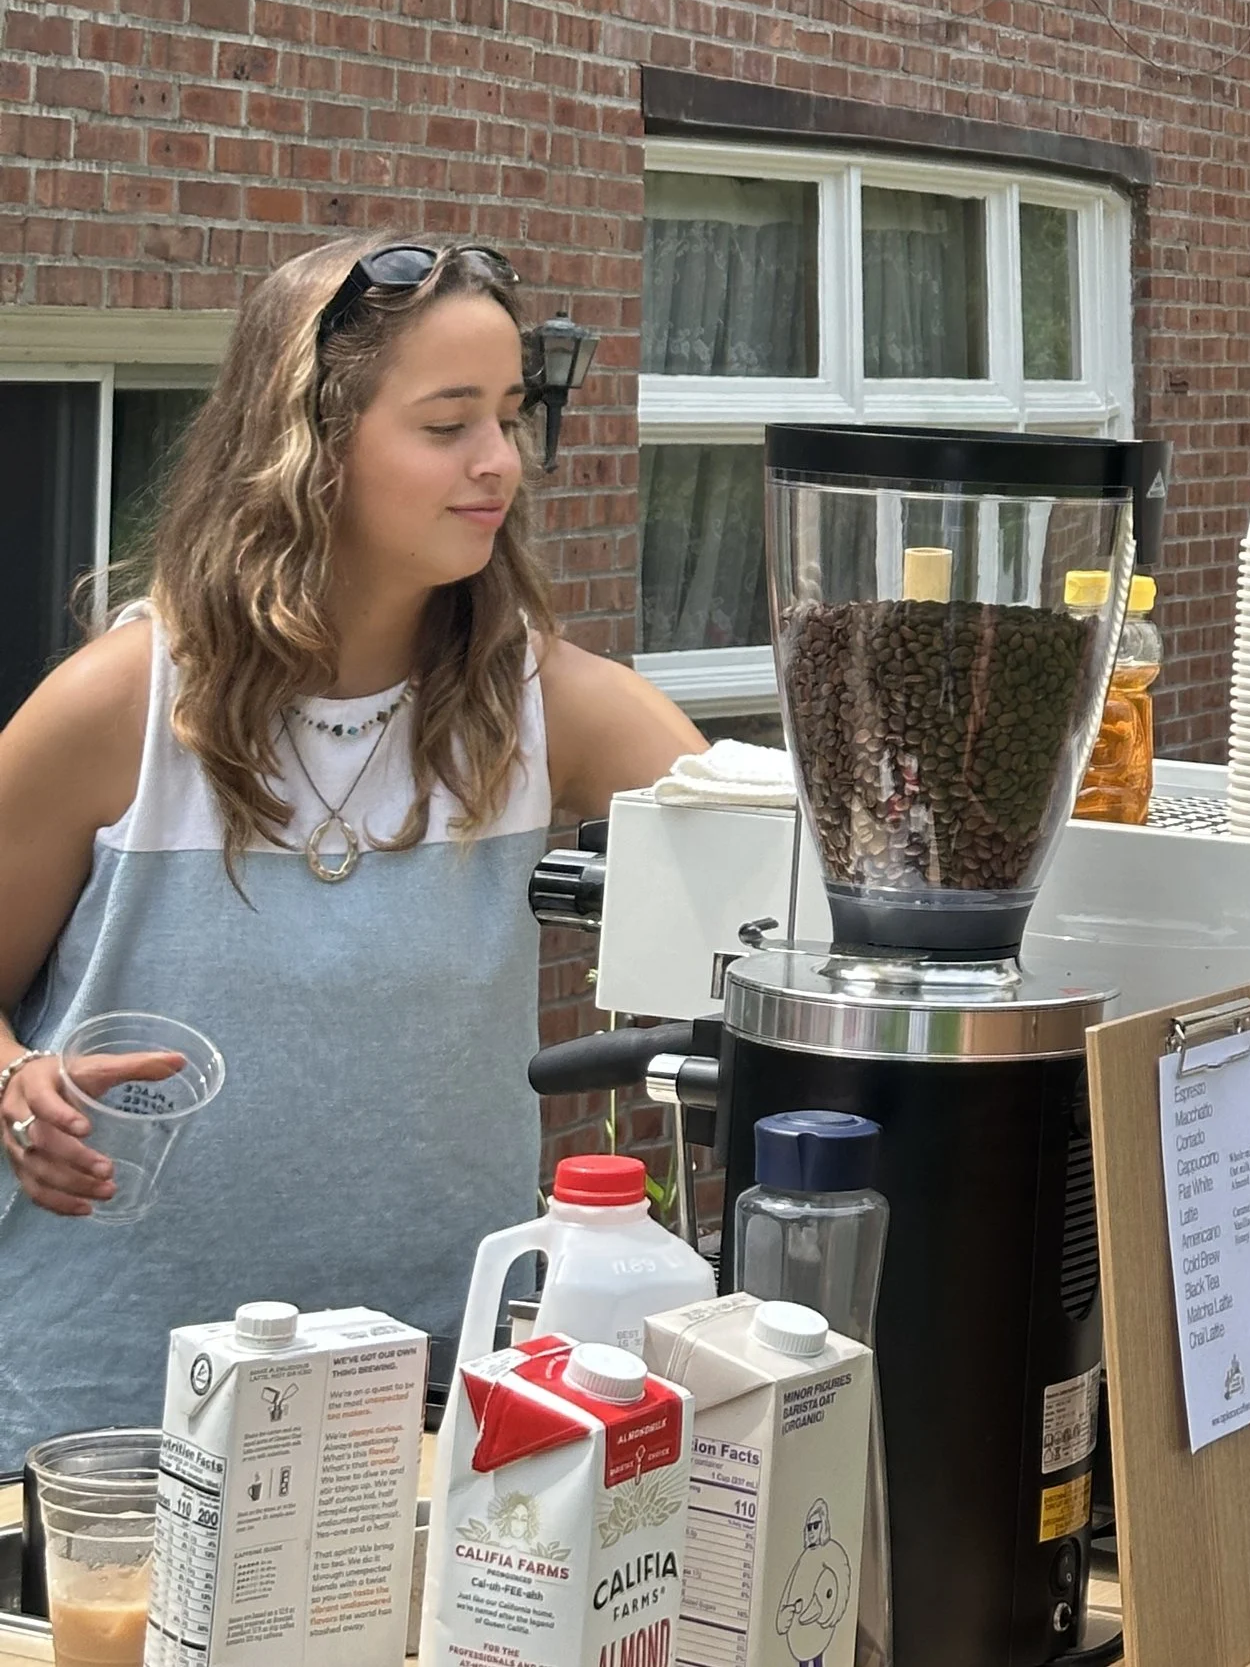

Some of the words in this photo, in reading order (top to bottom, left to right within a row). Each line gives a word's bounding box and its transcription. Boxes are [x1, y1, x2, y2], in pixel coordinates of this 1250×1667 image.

[1174, 1082, 1206, 1103] Espresso
[1175, 1102, 1213, 1126] Macchiato
[1176, 1129, 1205, 1151] Cortado
[1177, 1150, 1220, 1176] Cappuccino
[1192, 1175, 1213, 1196] White
[1180, 1206, 1198, 1226] Latte
[1182, 1224, 1221, 1249] Americano
[1183, 1254, 1200, 1275] Cold
[1200, 1251, 1220, 1269] Brew
[1185, 1276, 1205, 1300] Black
[1205, 1274, 1220, 1291] Tea
[1187, 1302, 1214, 1325] Matcha
[1214, 1293, 1233, 1314] Latte
[1189, 1326, 1205, 1350] Chai
[1206, 1323, 1225, 1343] Latte
[333, 1355, 358, 1365] WE'VE
[360, 1353, 376, 1362] GOT
[378, 1350, 395, 1359] OUR
[397, 1347, 417, 1357] OWN
[332, 1368, 357, 1378] THING
[784, 1386, 813, 1404] MINOR
[815, 1373, 852, 1394] FIGURES
[783, 1398, 818, 1419] BARISTA
[820, 1392, 836, 1406] OAT
[782, 1409, 824, 1436] (ORGANIC)
[163, 1439, 196, 1460] utrition
[196, 1451, 223, 1473] Facts
[721, 1443, 760, 1465] Facts
[716, 1473, 730, 1482] Cup
[177, 1498, 192, 1516] 110
[198, 1508, 219, 1526] 200
[734, 1499, 756, 1518] 110
[455, 1544, 514, 1568] CALIFIA
[518, 1558, 570, 1580] FARMS
[340, 1580, 357, 1588] with
[366, 1576, 386, 1584] twist
[593, 1551, 678, 1610] CALIFIA
[458, 1592, 471, 1600] Just
[473, 1595, 484, 1604] like
[498, 1601, 531, 1614] California
[475, 1608, 497, 1617] named
[499, 1612, 515, 1621] after
[516, 1615, 528, 1623] the
[530, 1618, 555, 1629] legend
[449, 1645, 515, 1666] PROFESSIONALS
[484, 1643, 500, 1652] FOR
[502, 1647, 520, 1658] THE
